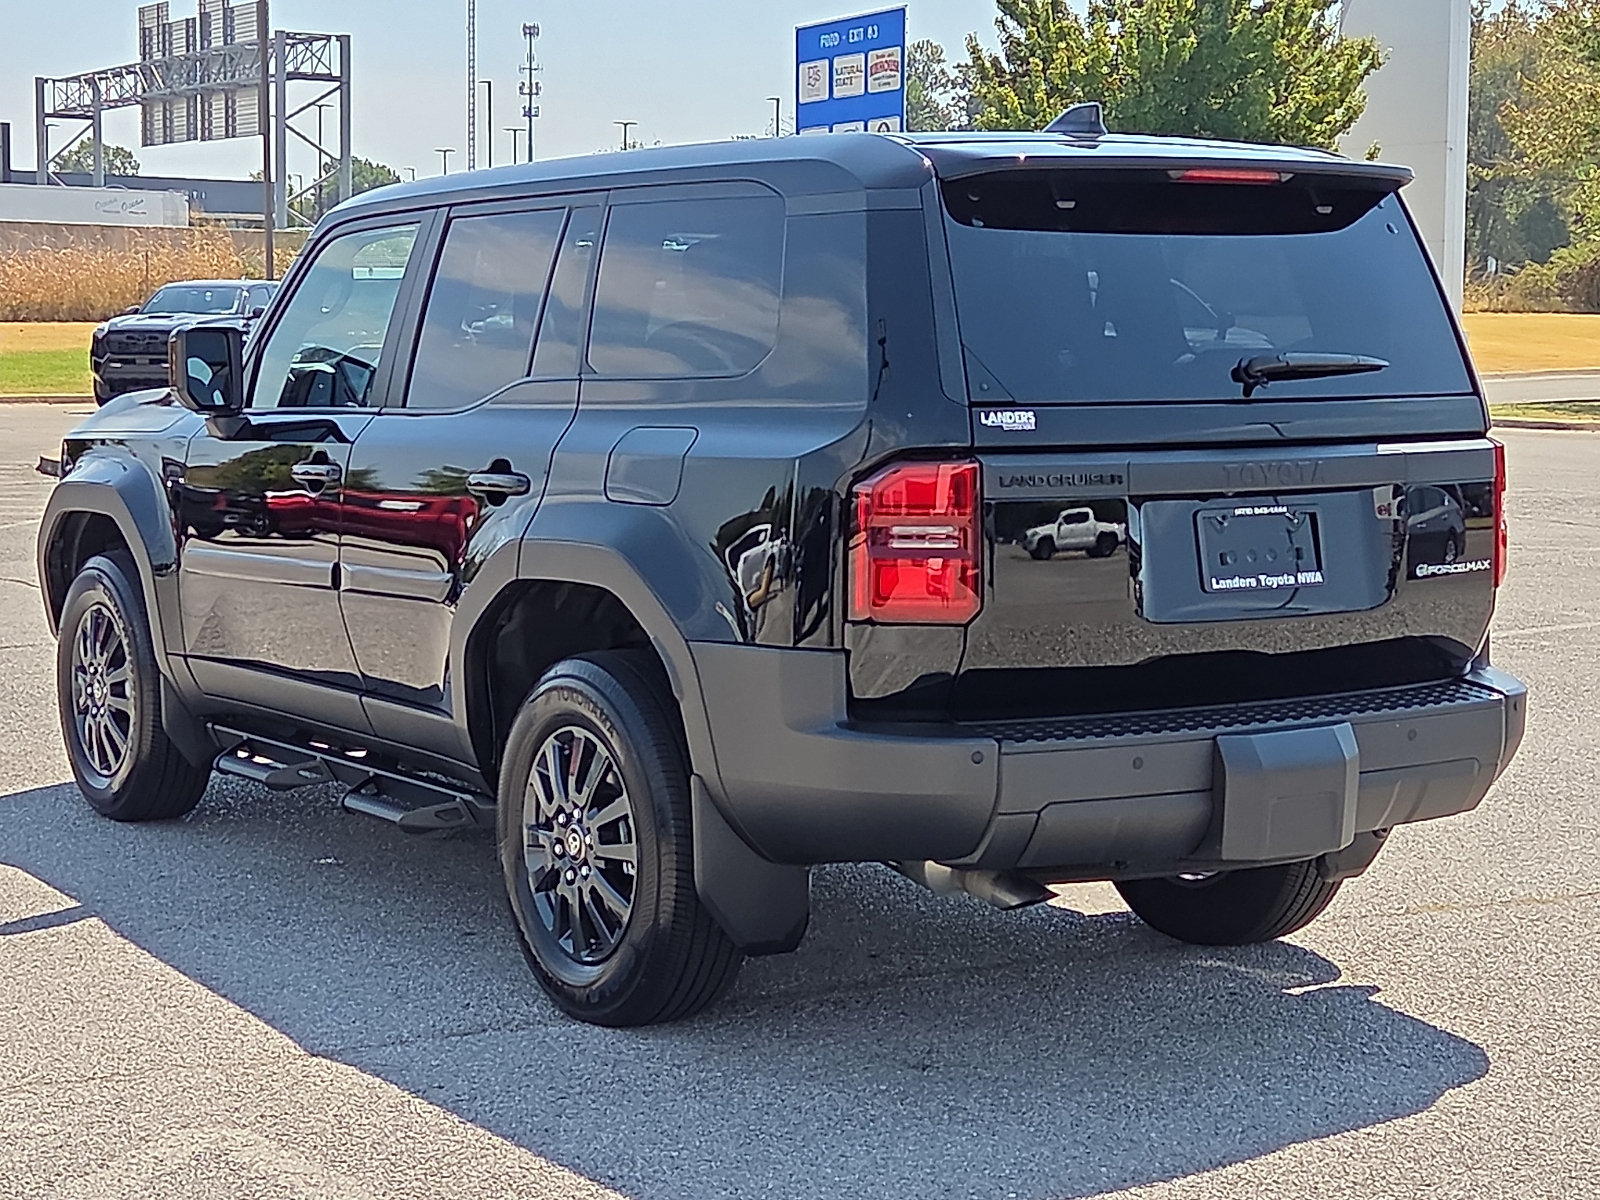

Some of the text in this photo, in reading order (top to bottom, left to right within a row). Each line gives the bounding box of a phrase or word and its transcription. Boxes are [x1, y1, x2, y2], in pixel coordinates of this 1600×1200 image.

[980, 411, 1036, 425] LANDERS
[1222, 461, 1324, 487] TOYOTA
[1211, 571, 1323, 589] Landers Toyota NWA
